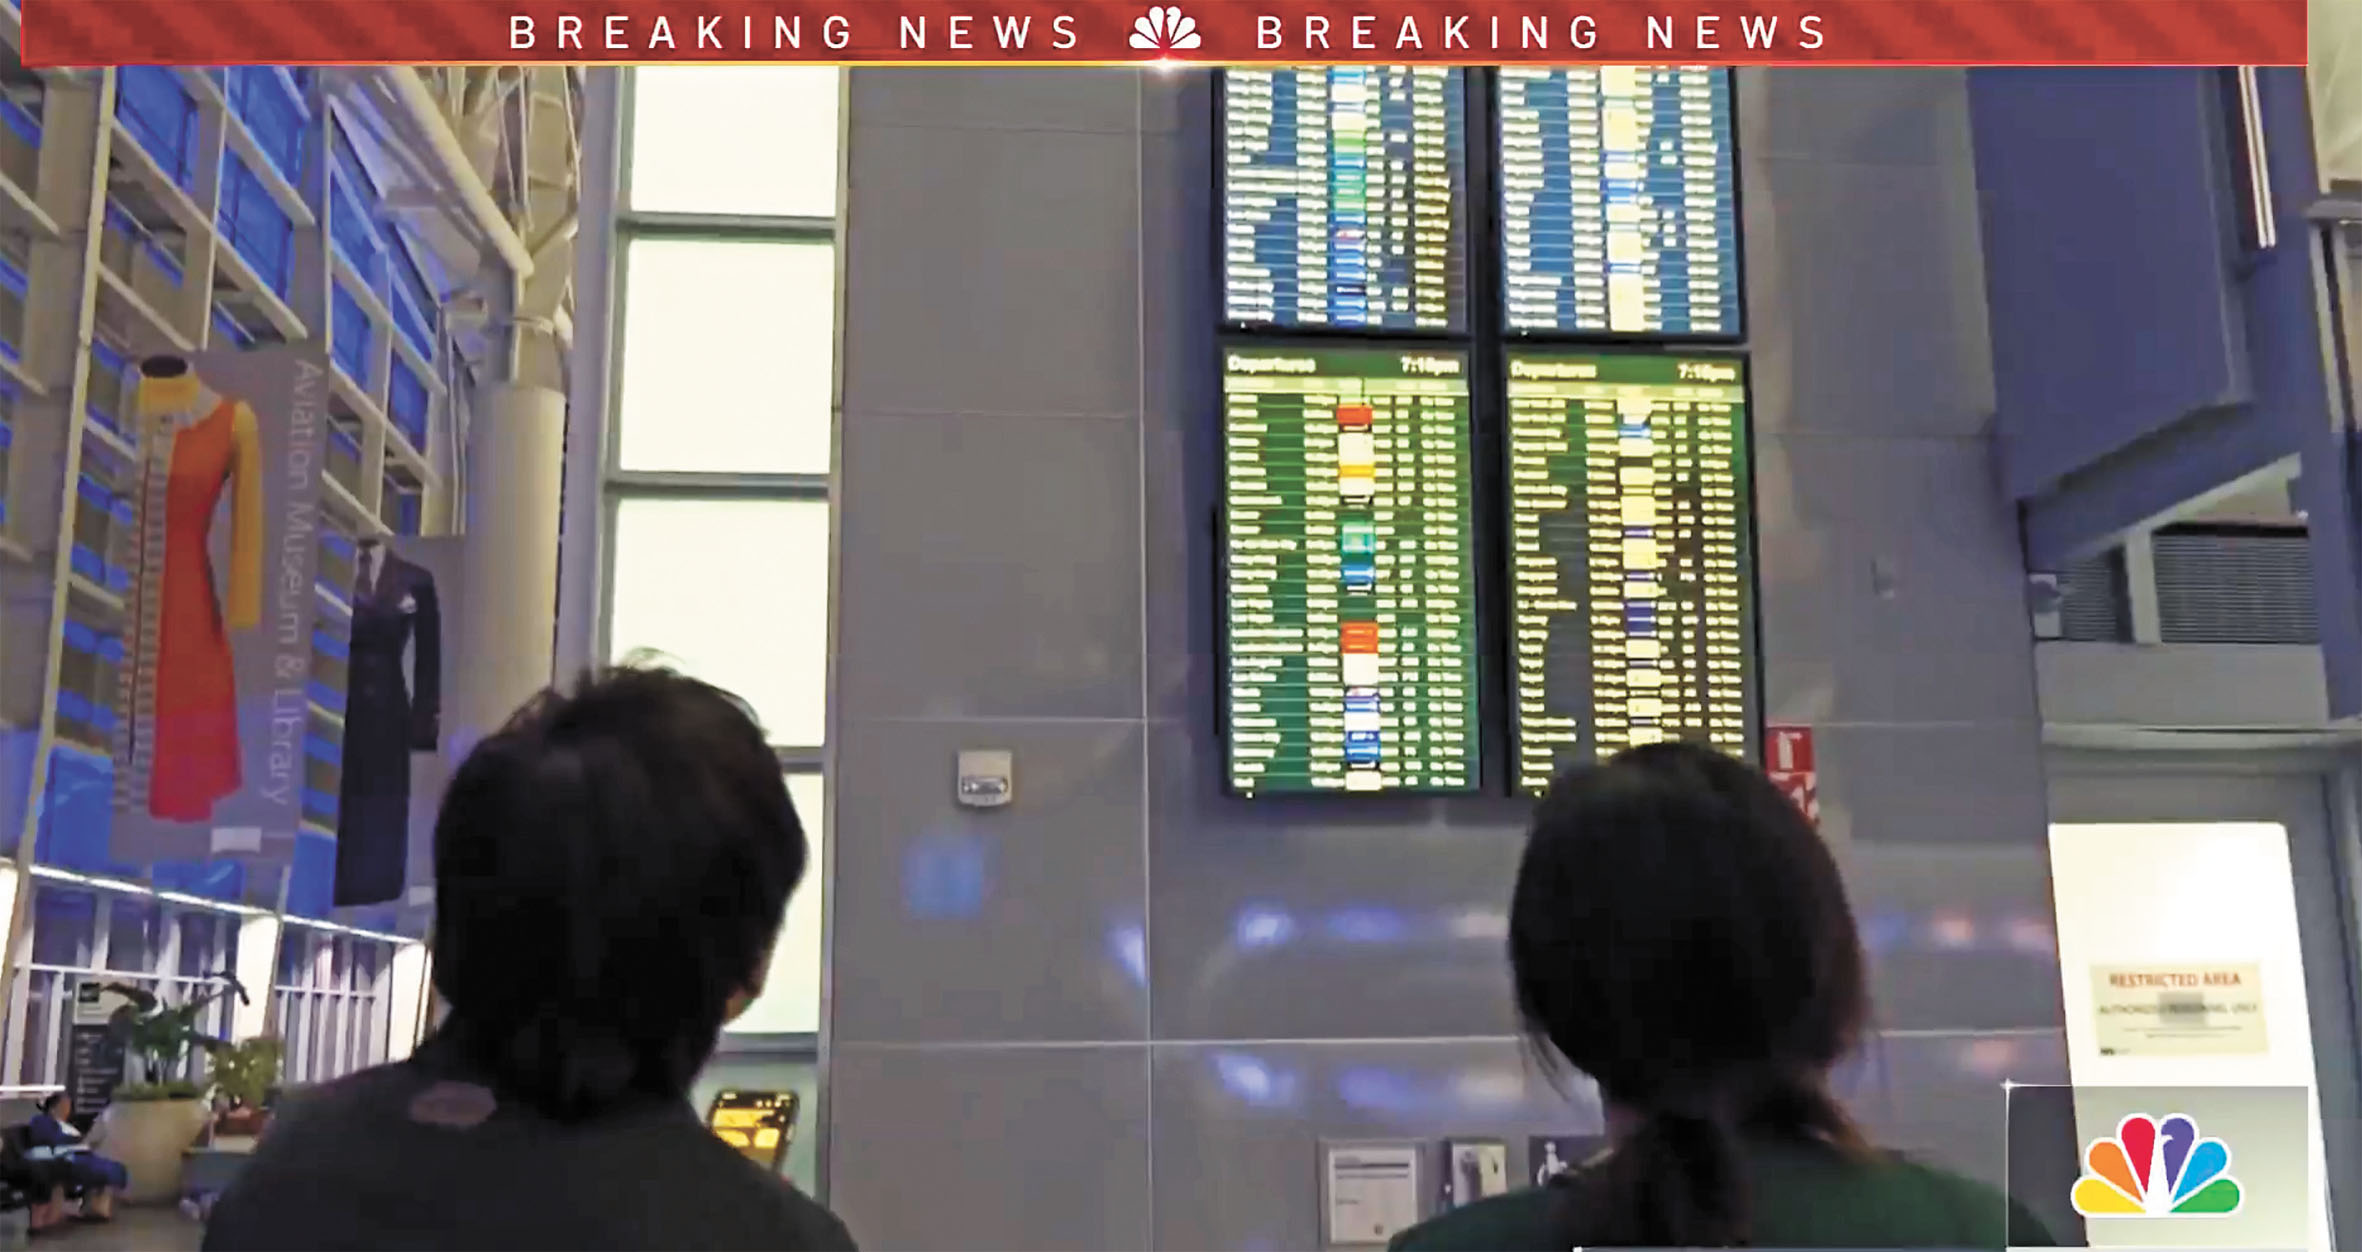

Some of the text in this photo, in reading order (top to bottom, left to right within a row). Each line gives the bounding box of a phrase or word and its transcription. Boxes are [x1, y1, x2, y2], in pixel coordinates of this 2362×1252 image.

[259, 358, 324, 805] Aviation Museum & Library
[2109, 971, 2242, 988] RESTRICTED AREA
